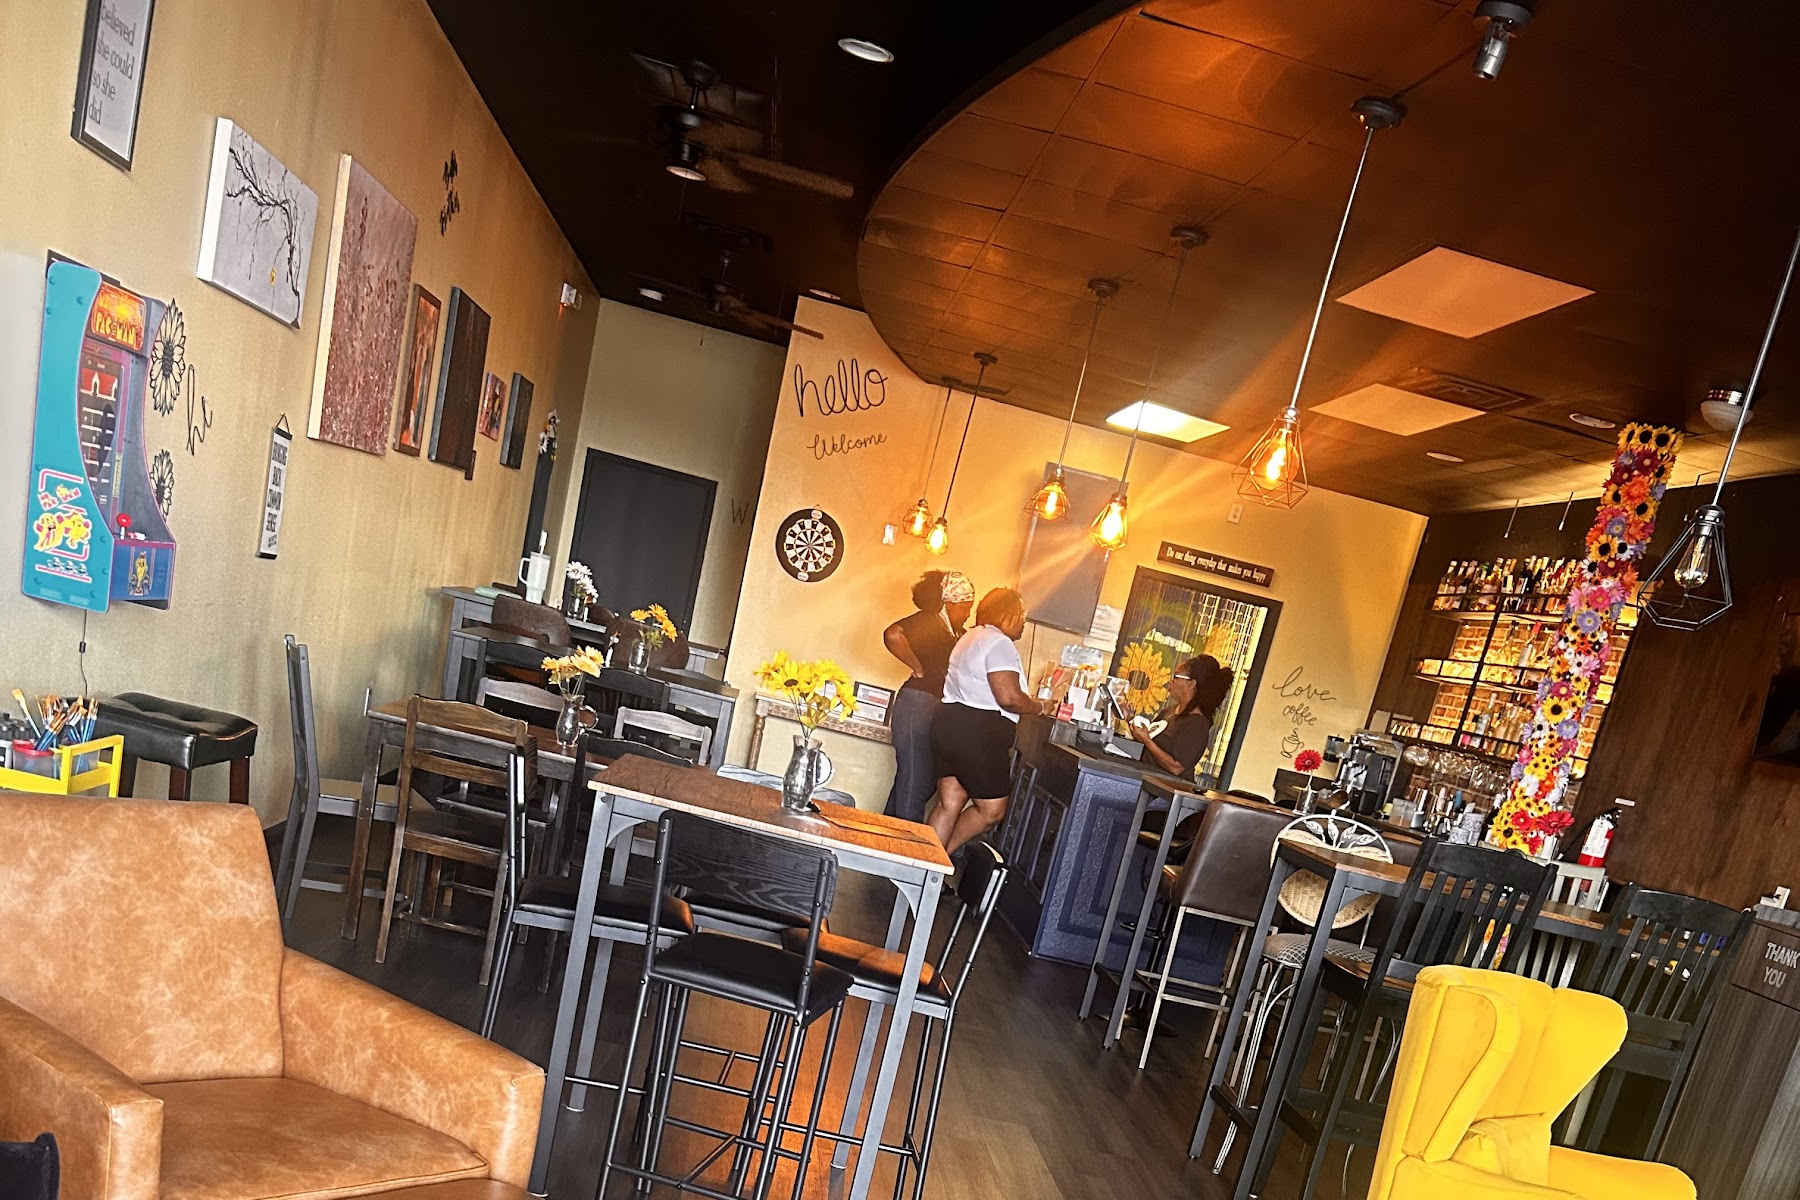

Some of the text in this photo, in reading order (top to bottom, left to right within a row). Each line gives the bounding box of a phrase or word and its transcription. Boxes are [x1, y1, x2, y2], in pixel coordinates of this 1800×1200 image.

[97, 30, 134, 80] she could
[91, 69, 116, 101] so she
[88, 95, 103, 125] did
[794, 358, 888, 417] hello
[807, 433, 887, 460] Welcome
[1166, 546, 1175, 558] Do
[1272, 666, 1337, 700] love
[1282, 703, 1317, 726] coffee
[1765, 942, 1800, 969] THANK
[1763, 966, 1787, 989] YOU
